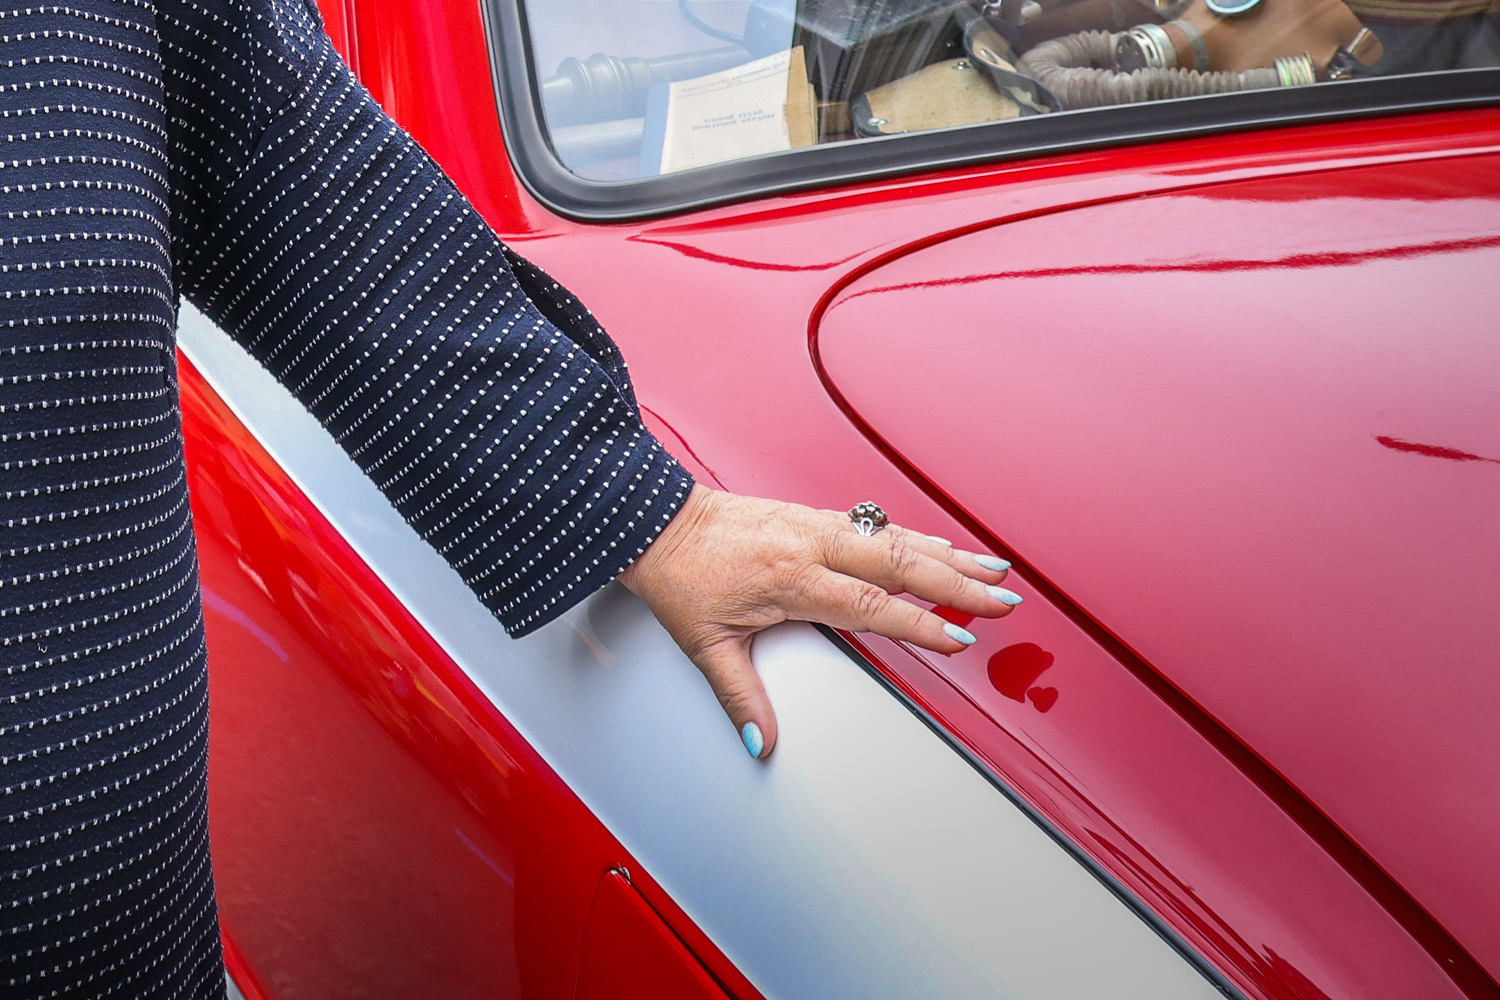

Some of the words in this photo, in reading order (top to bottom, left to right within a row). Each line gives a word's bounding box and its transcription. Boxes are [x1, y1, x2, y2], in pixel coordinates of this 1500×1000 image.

[738, 109, 764, 119] УСТАВ
[692, 119, 738, 131] ПОЖАРНОЙ
[740, 113, 775, 124] ОХРАНЫ
